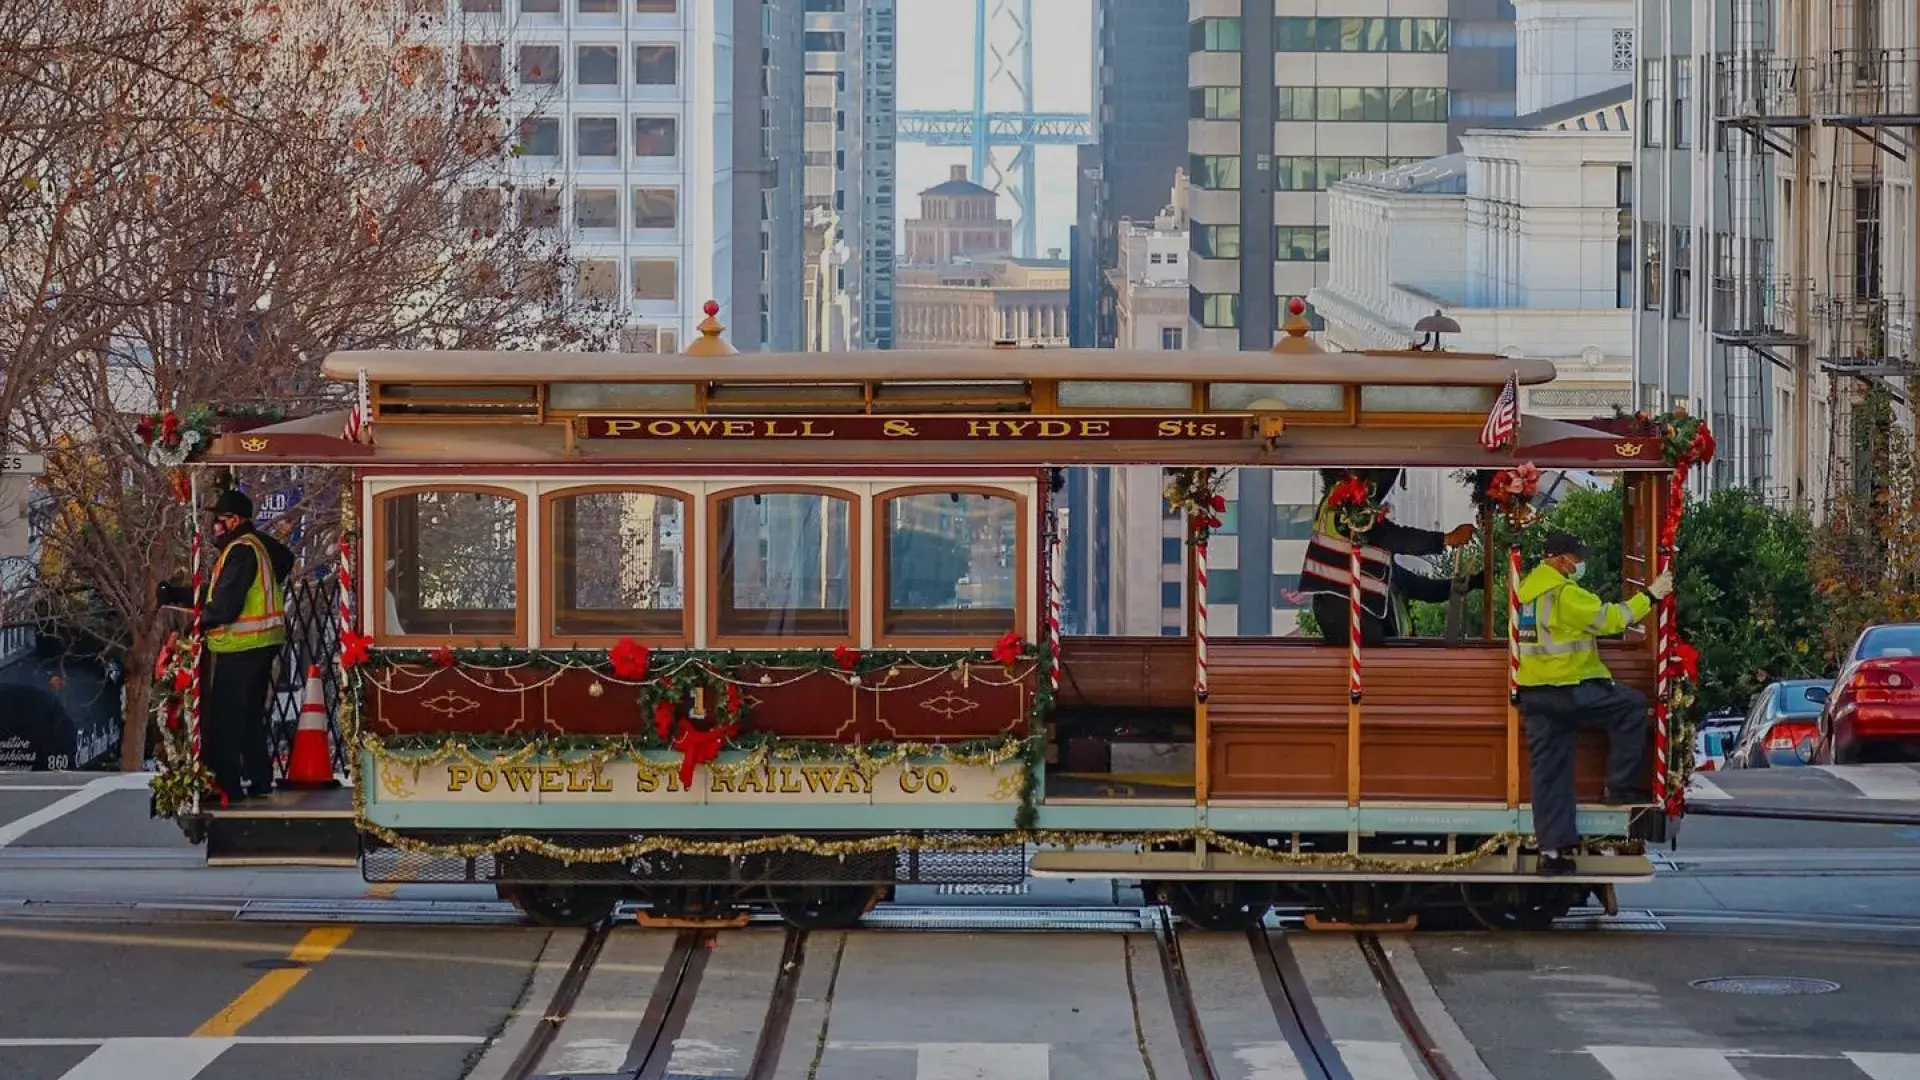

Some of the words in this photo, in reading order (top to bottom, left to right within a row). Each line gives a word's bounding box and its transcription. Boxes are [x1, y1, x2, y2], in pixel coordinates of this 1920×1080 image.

[605, 419, 834, 437] POWELL
[883, 419, 919, 437] &
[967, 420, 1110, 437] HYDE
[1157, 420, 1226, 437] Sts.
[689, 686, 706, 719] 1
[47, 754, 69, 770] 860
[447, 766, 613, 792] POWELL
[711, 766, 877, 792] RAILWAY
[899, 766, 957, 793] CO.
